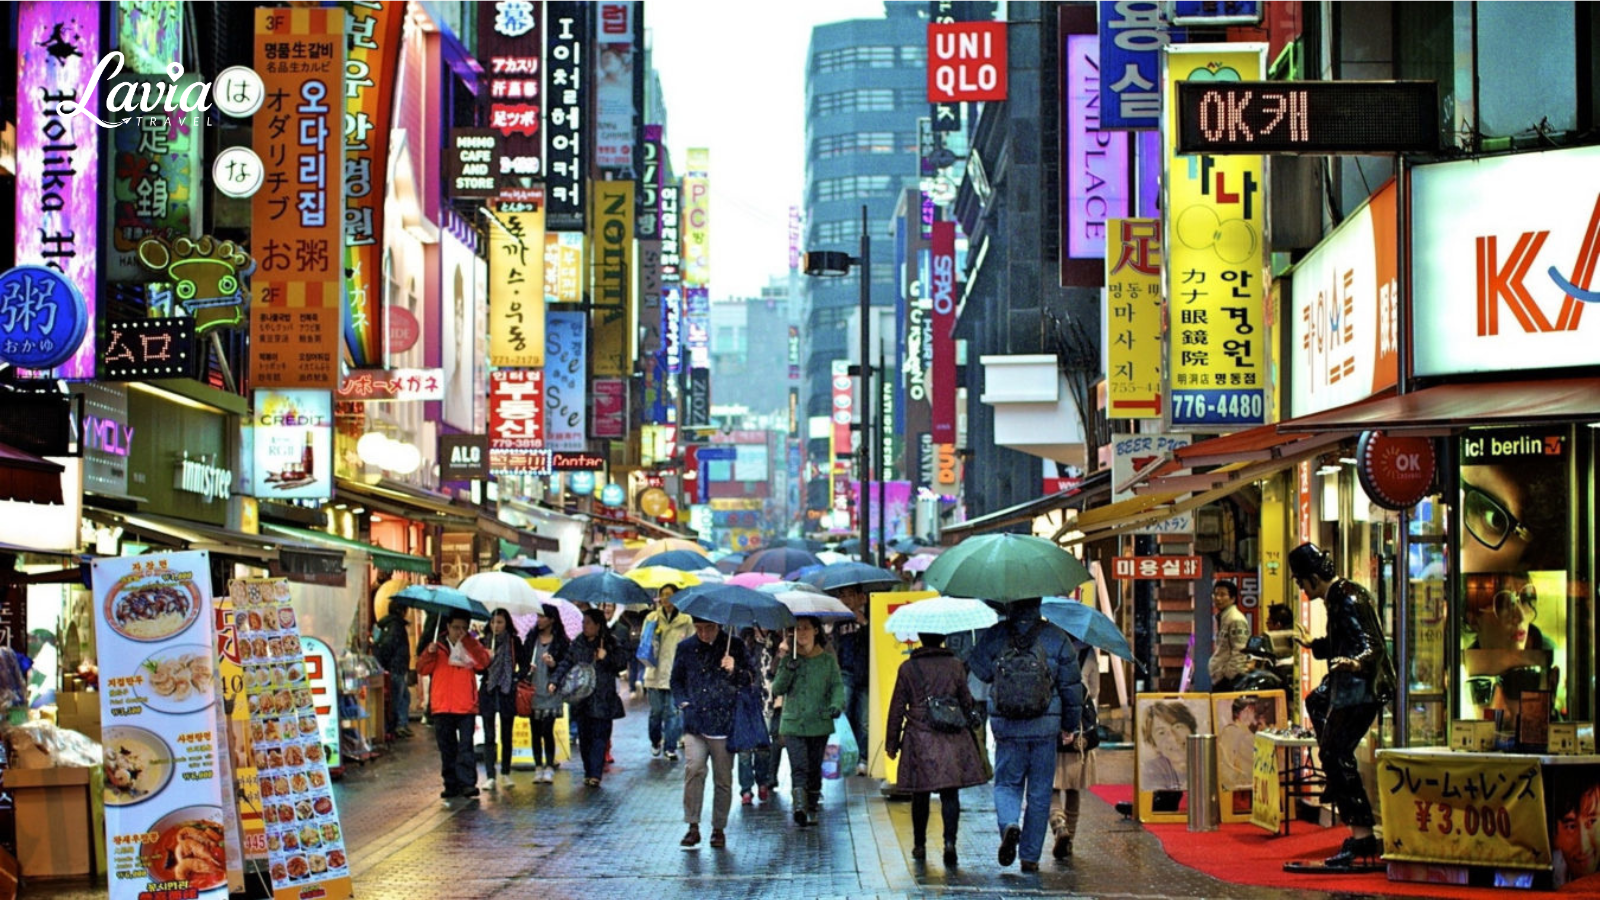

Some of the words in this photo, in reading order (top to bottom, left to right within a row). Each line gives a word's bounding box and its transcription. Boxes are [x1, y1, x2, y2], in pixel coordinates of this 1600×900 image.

[265, 15, 284, 30] 3F
[936, 32, 992, 59] UNI
[492, 57, 538, 73] アカスリ
[225, 79, 250, 103] は
[936, 64, 998, 96] QLO
[297, 79, 328, 228] 오다리집
[459, 150, 492, 162] CAFE
[226, 160, 251, 183] な
[462, 164, 489, 175] AND
[456, 177, 494, 189] STORE
[260, 239, 329, 274] お粥
[261, 286, 280, 303] 2F
[933, 256, 953, 315] SPAO
[1108, 282, 1142, 299] 명동
[0, 274, 58, 334] 粥
[1180, 269, 1209, 367] カナ眼鏡院
[1220, 270, 1255, 368] 안경원
[4, 339, 54, 354] おかゆ
[546, 332, 580, 374] See
[1113, 302, 1136, 382] 마사지
[1177, 373, 1209, 386] 明洞店
[1215, 373, 1256, 386] 명동점
[545, 385, 580, 428] See
[1172, 394, 1262, 419] 776-4480
[450, 446, 481, 463] ALO
[1116, 437, 1153, 456] BEER
[1465, 438, 1484, 458] ic!
[1491, 437, 1542, 457] berlin
[1396, 454, 1420, 471] OK
[181, 449, 232, 503] innisfree
[1116, 559, 1180, 577] 미용실
